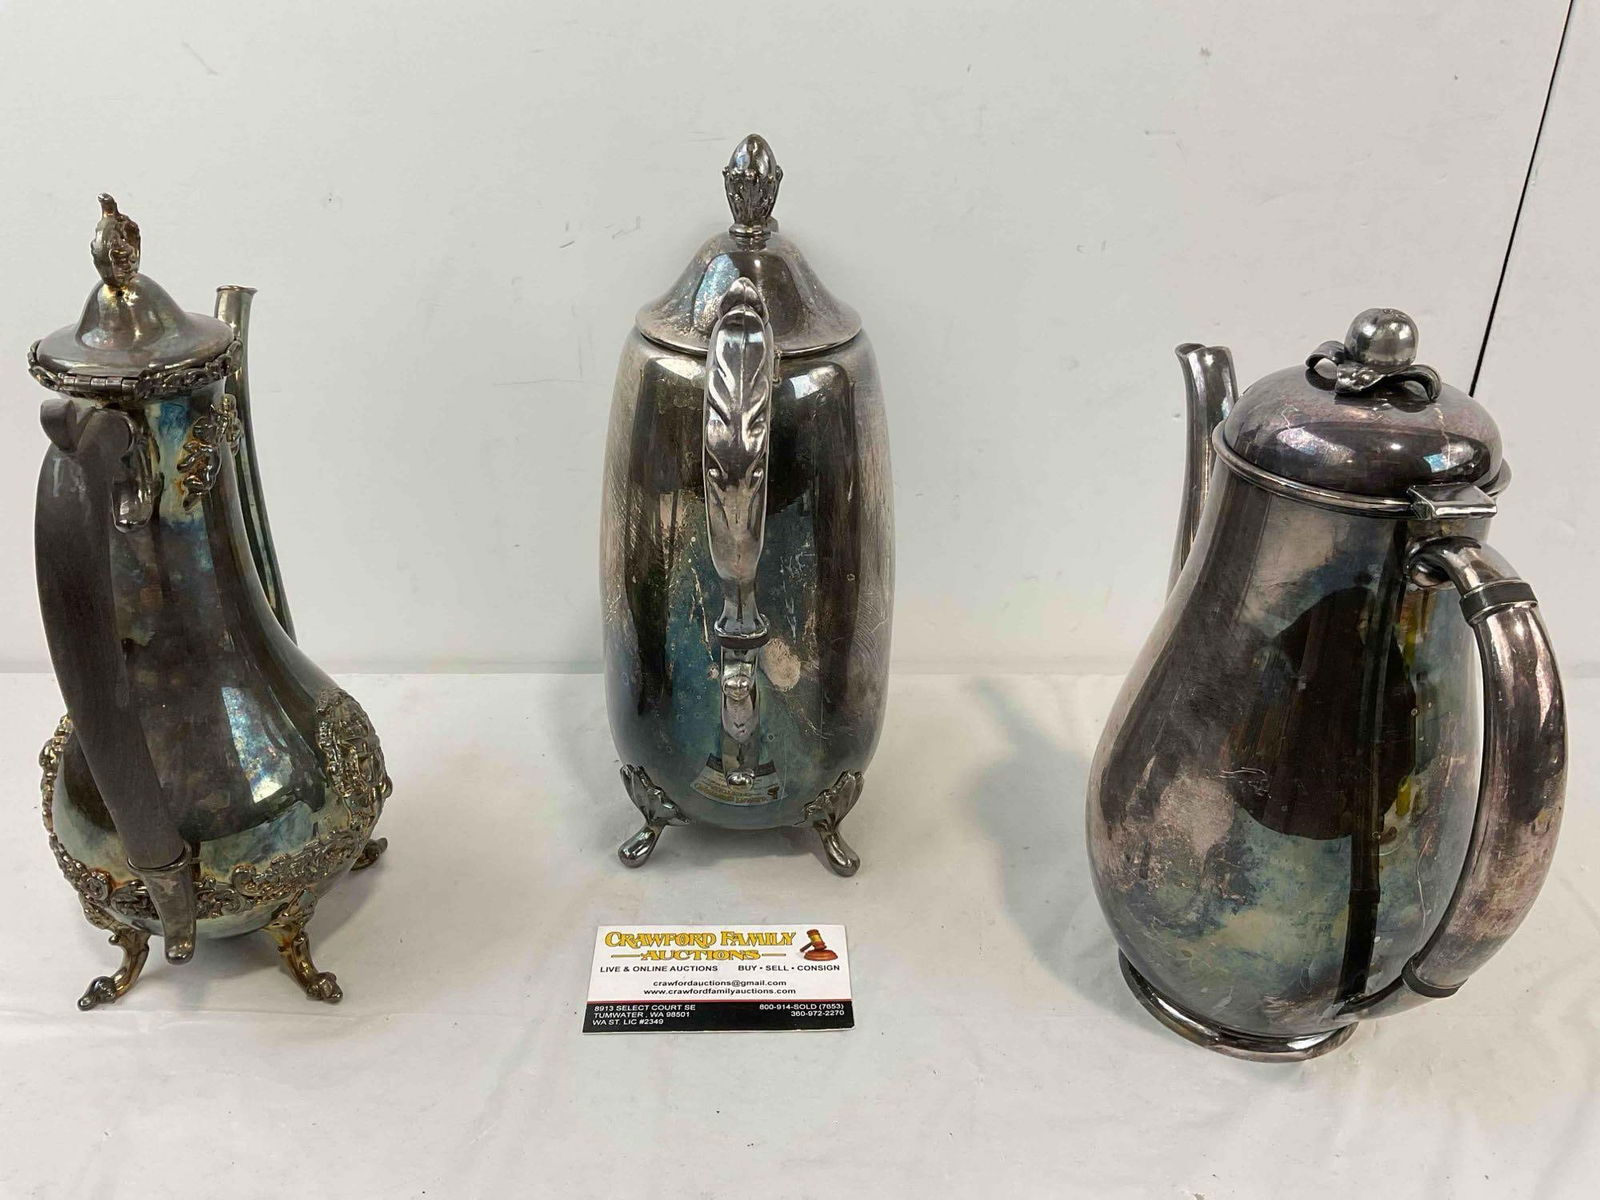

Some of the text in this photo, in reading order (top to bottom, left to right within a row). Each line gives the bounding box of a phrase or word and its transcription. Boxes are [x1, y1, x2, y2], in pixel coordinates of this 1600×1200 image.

[604, 930, 797, 950] CRAWFORD FAMILY
[640, 949, 762, 961] AUCTIONS
[652, 980, 788, 988] crawfordauctions@gmail.com
